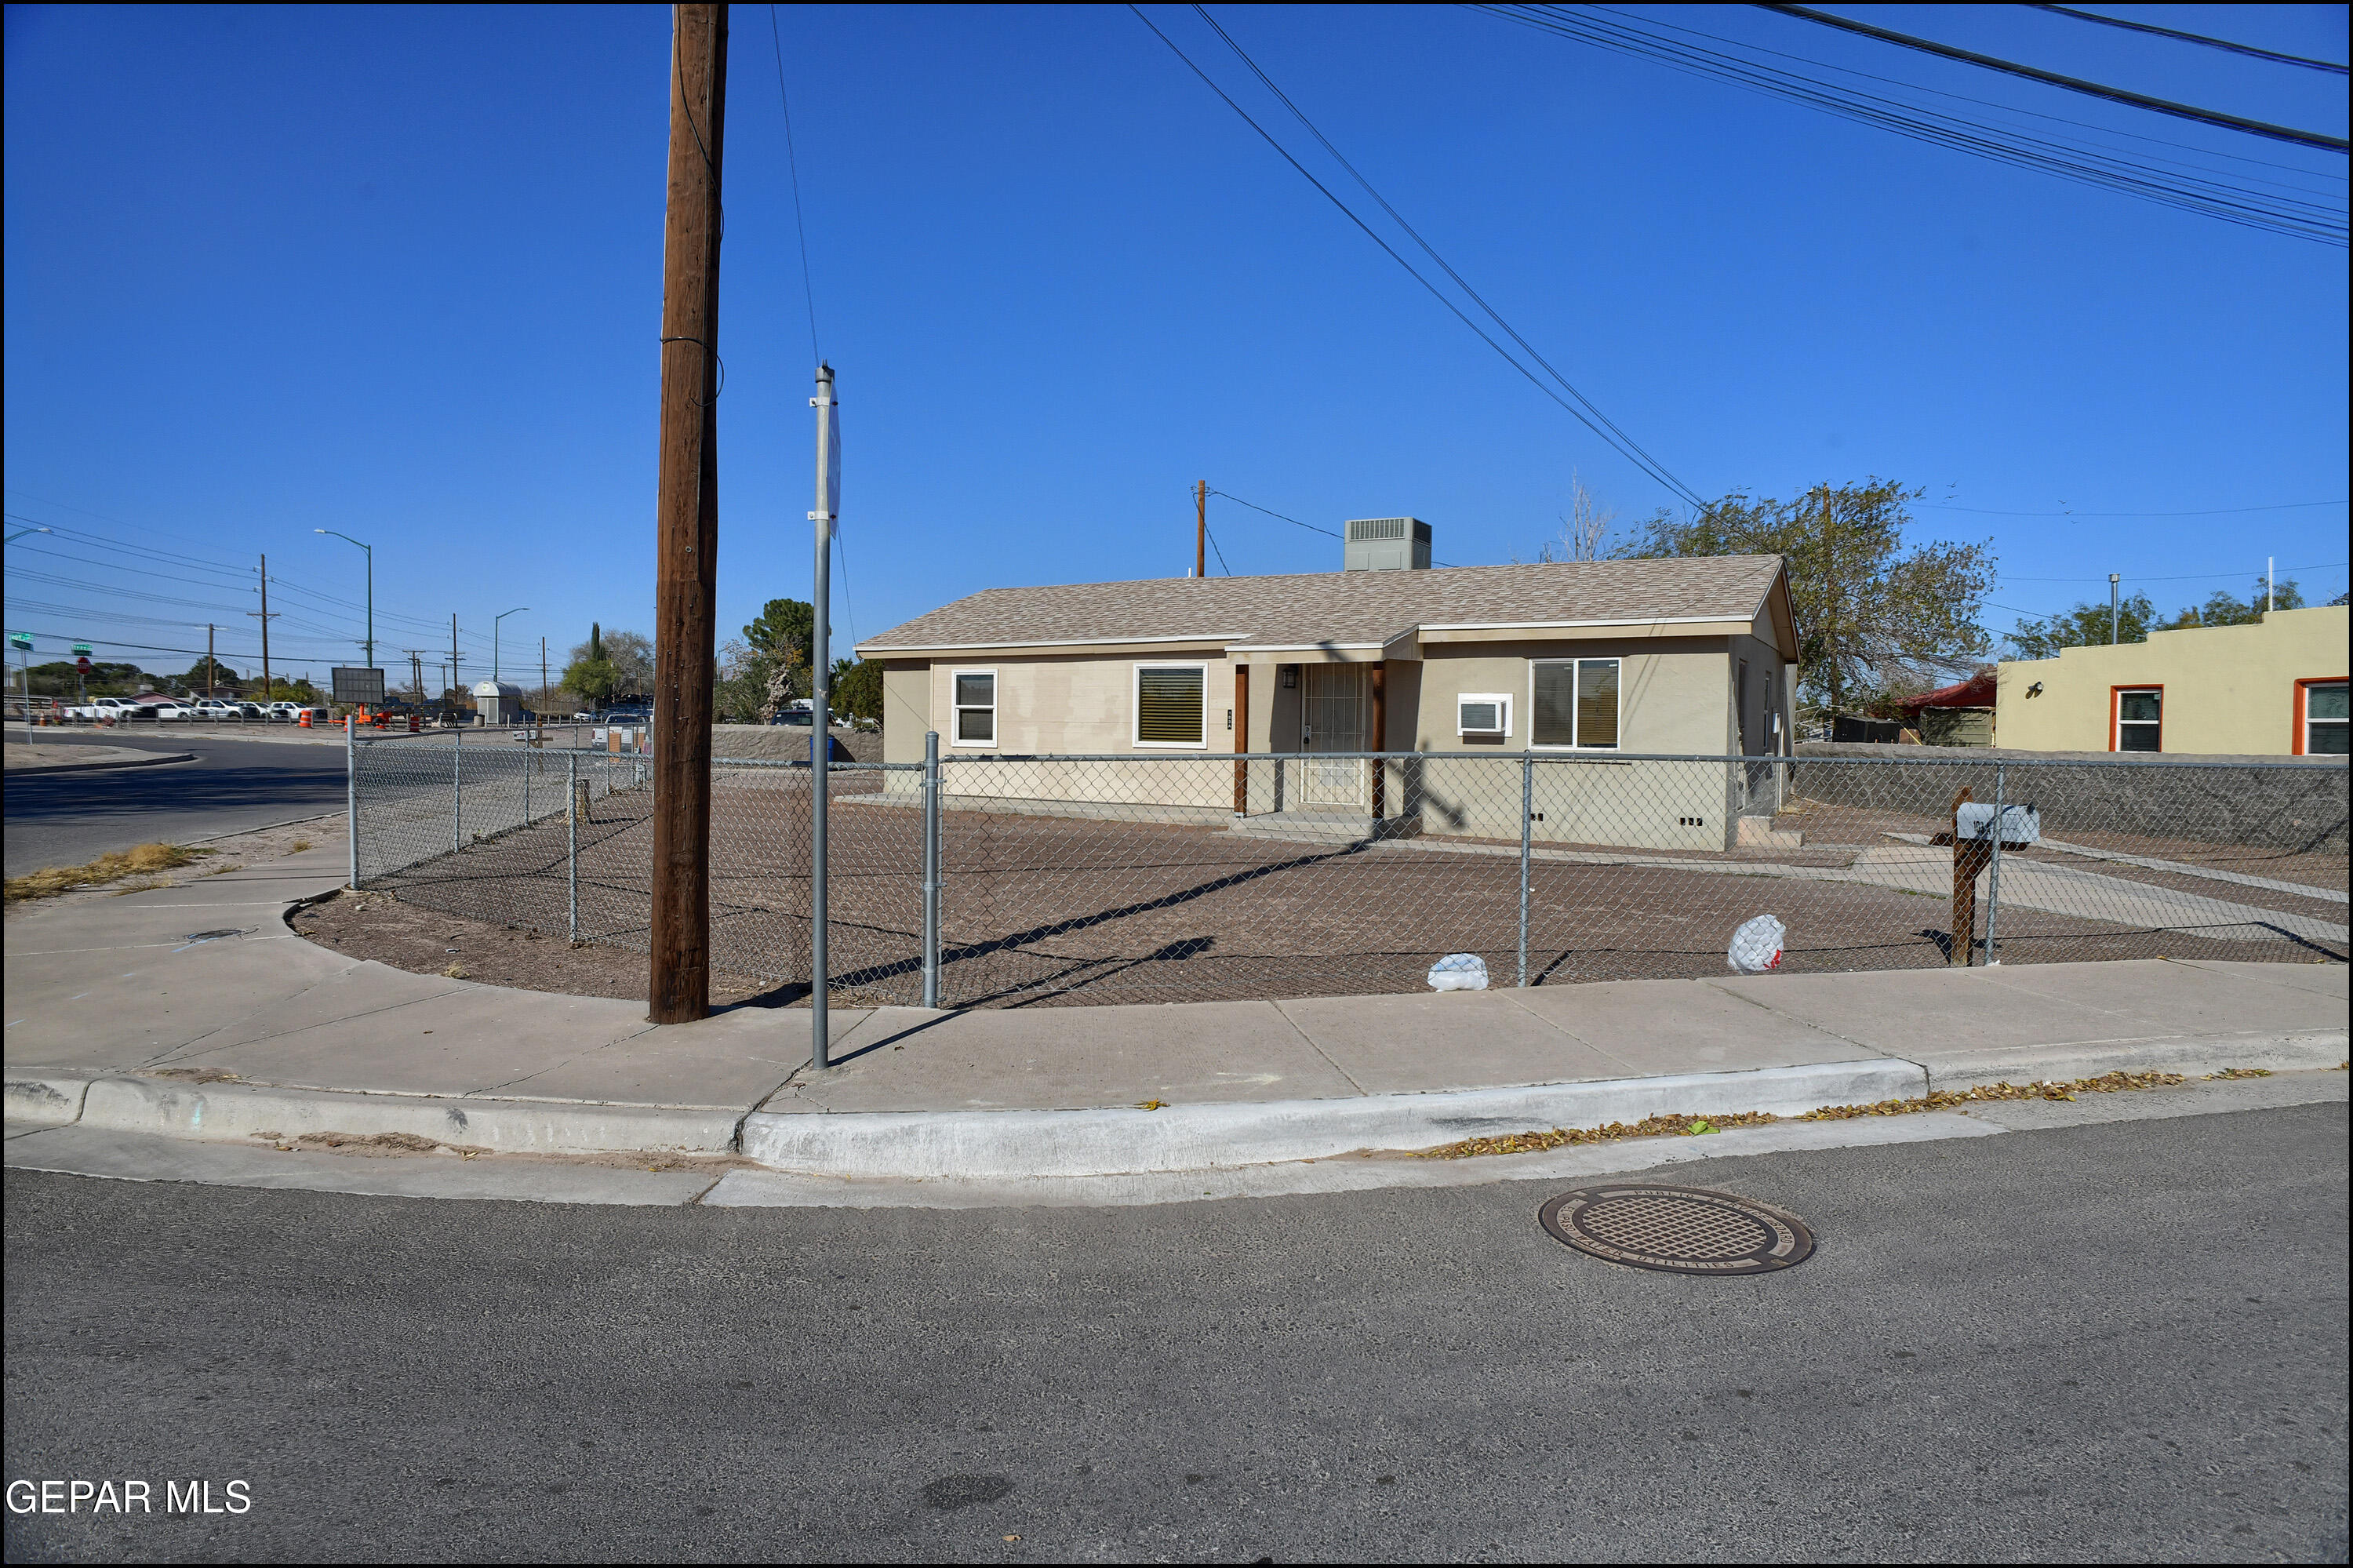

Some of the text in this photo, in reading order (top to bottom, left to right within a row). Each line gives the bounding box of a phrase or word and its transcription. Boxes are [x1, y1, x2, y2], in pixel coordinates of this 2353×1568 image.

[1558, 1215, 1577, 1232] PASO
[1576, 1235, 1624, 1257] WATER
[1636, 1255, 1734, 1268] UTILITIES
[1633, 1190, 1793, 1245] PUBLIC SERVICE BOARD
